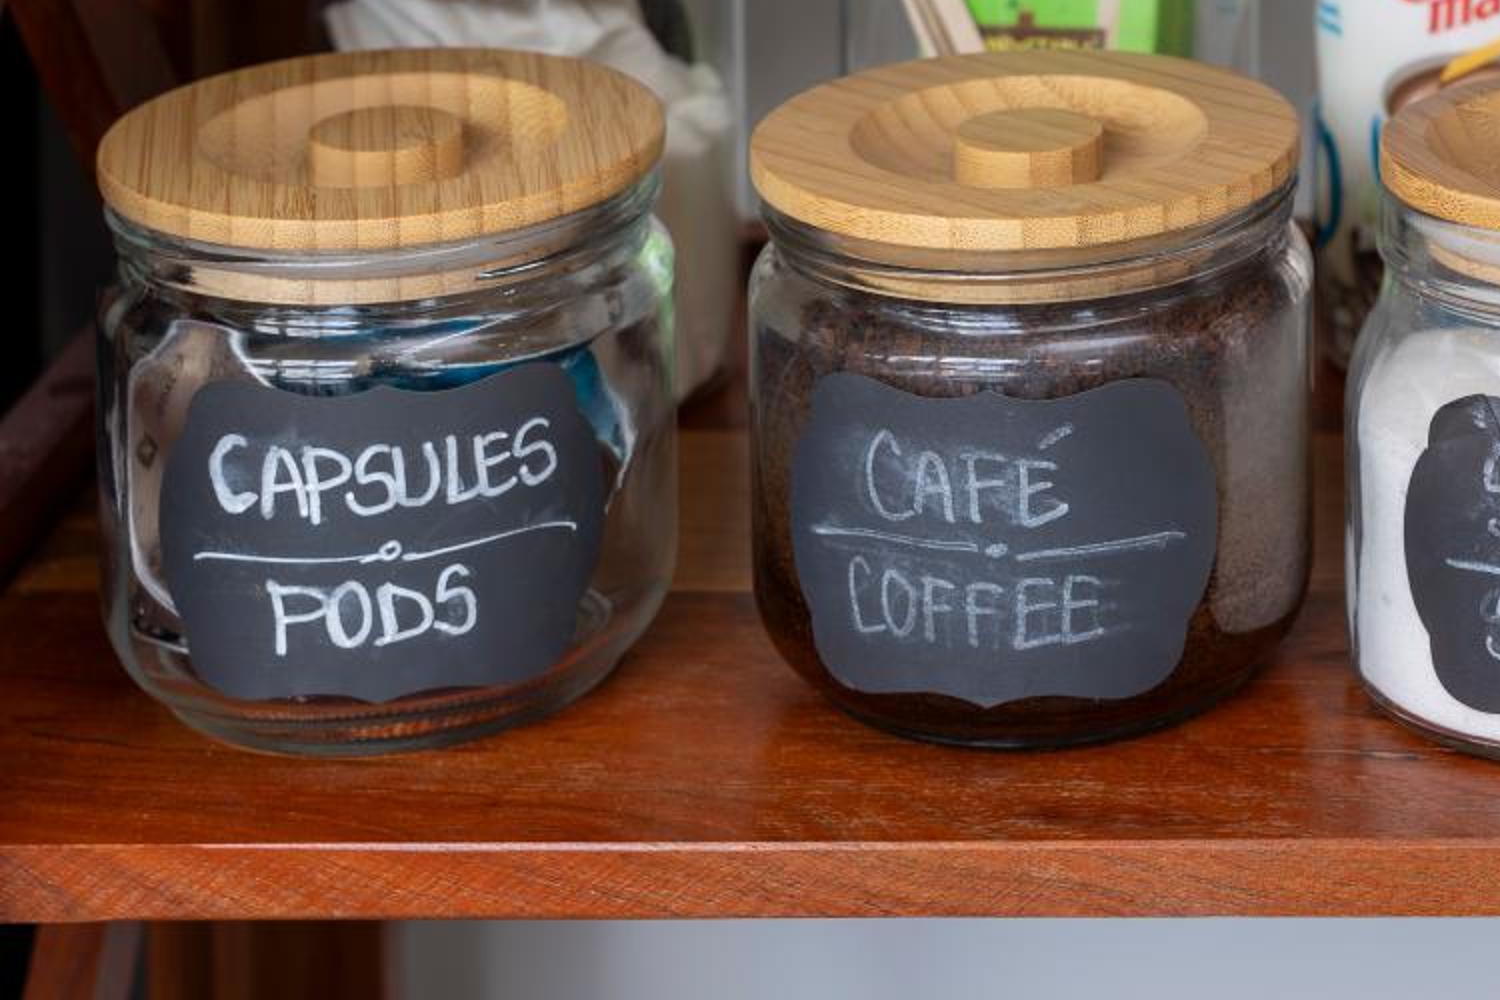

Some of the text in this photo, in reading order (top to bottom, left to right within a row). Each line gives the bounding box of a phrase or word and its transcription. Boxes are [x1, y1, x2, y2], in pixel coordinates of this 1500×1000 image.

[209, 417, 558, 525] CAPSULES
[866, 423, 1074, 528] CAFÉ
[266, 563, 477, 655] PODS
[848, 555, 1105, 651] COFFEE
